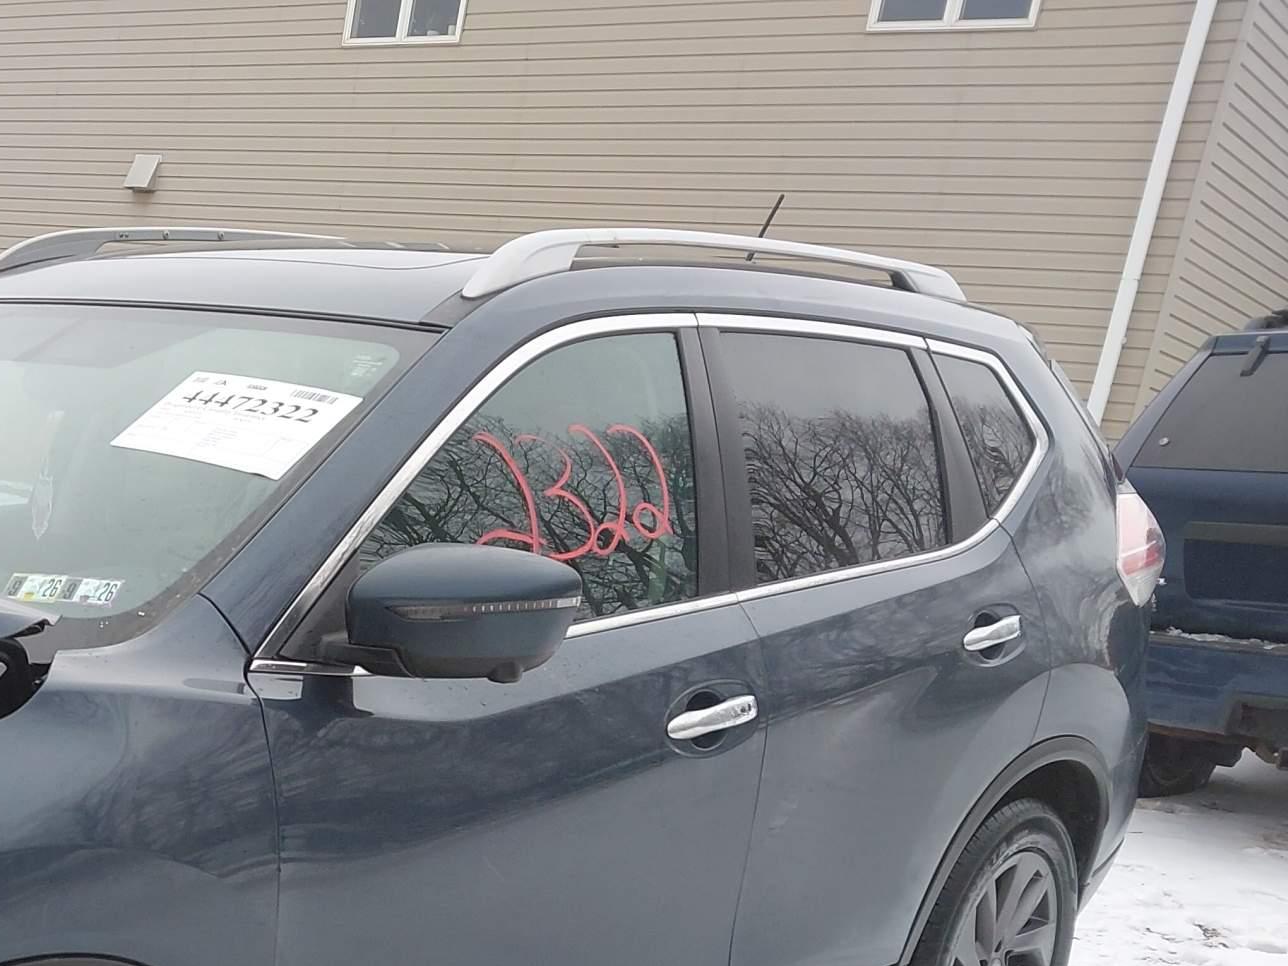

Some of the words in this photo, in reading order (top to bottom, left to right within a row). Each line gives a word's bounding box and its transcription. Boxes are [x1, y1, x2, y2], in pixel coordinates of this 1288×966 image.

[181, 391, 319, 424] 44472322
[42, 578, 63, 598] 26
[97, 582, 118, 602] 26
